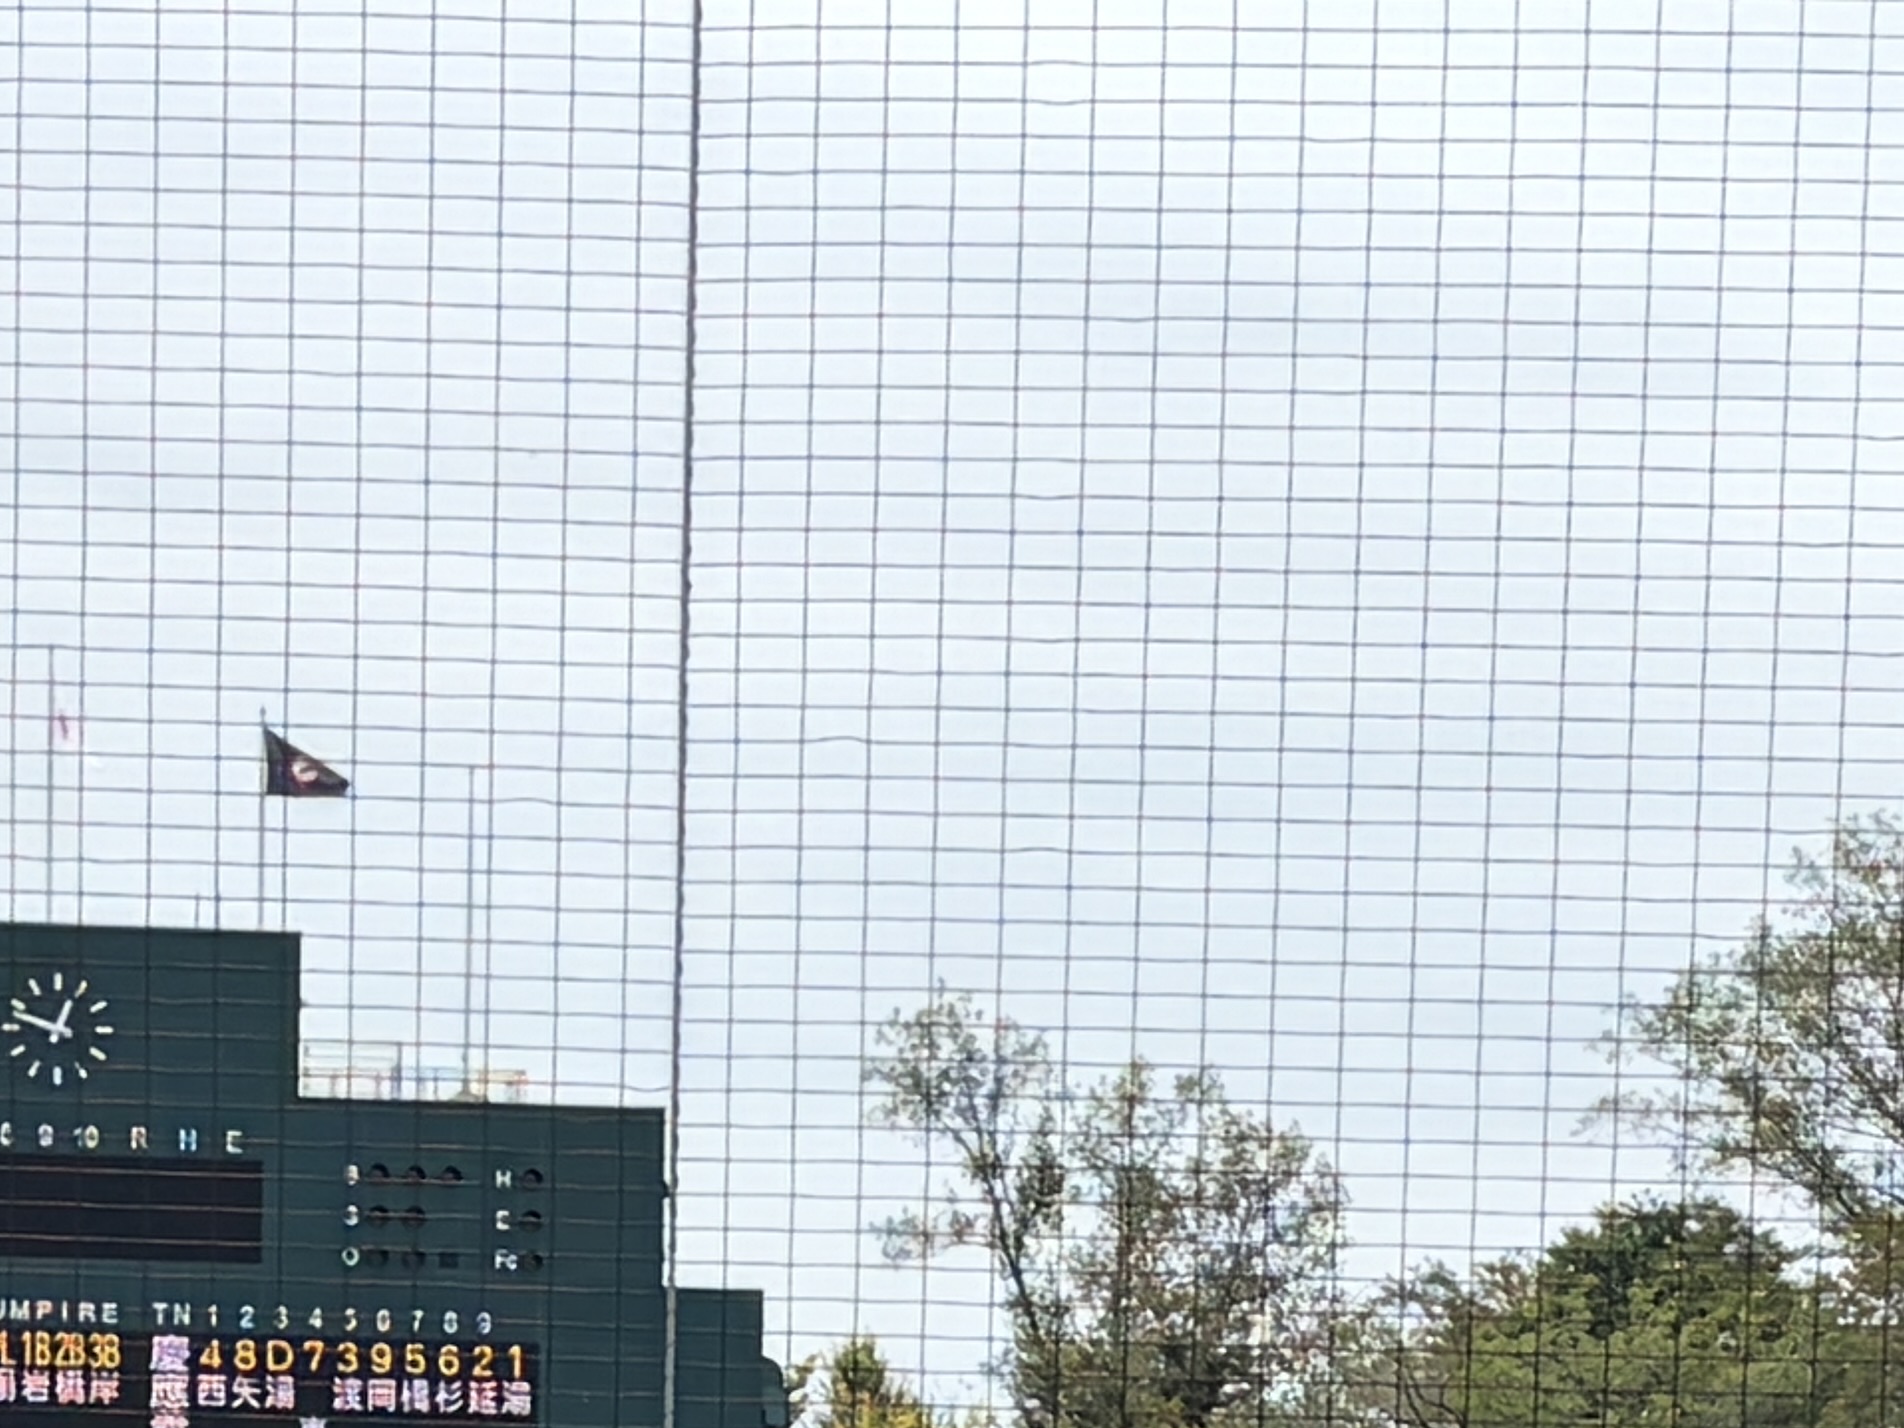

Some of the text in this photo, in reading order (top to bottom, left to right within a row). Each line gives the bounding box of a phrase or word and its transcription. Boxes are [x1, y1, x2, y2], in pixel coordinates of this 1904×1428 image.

[73, 1124, 99, 1149] 10
[130, 1126, 148, 1150] R
[179, 1128, 198, 1152] H
[495, 1170, 512, 1188] H
[207, 1304, 218, 1327] 1
[239, 1304, 255, 1329] 2
[273, 1305, 289, 1330] 3
[308, 1307, 323, 1329] 4
[412, 1309, 424, 1332] 7
[199, 1339, 522, 1379] 4 8 D 7 3 9 5 6 2 1
